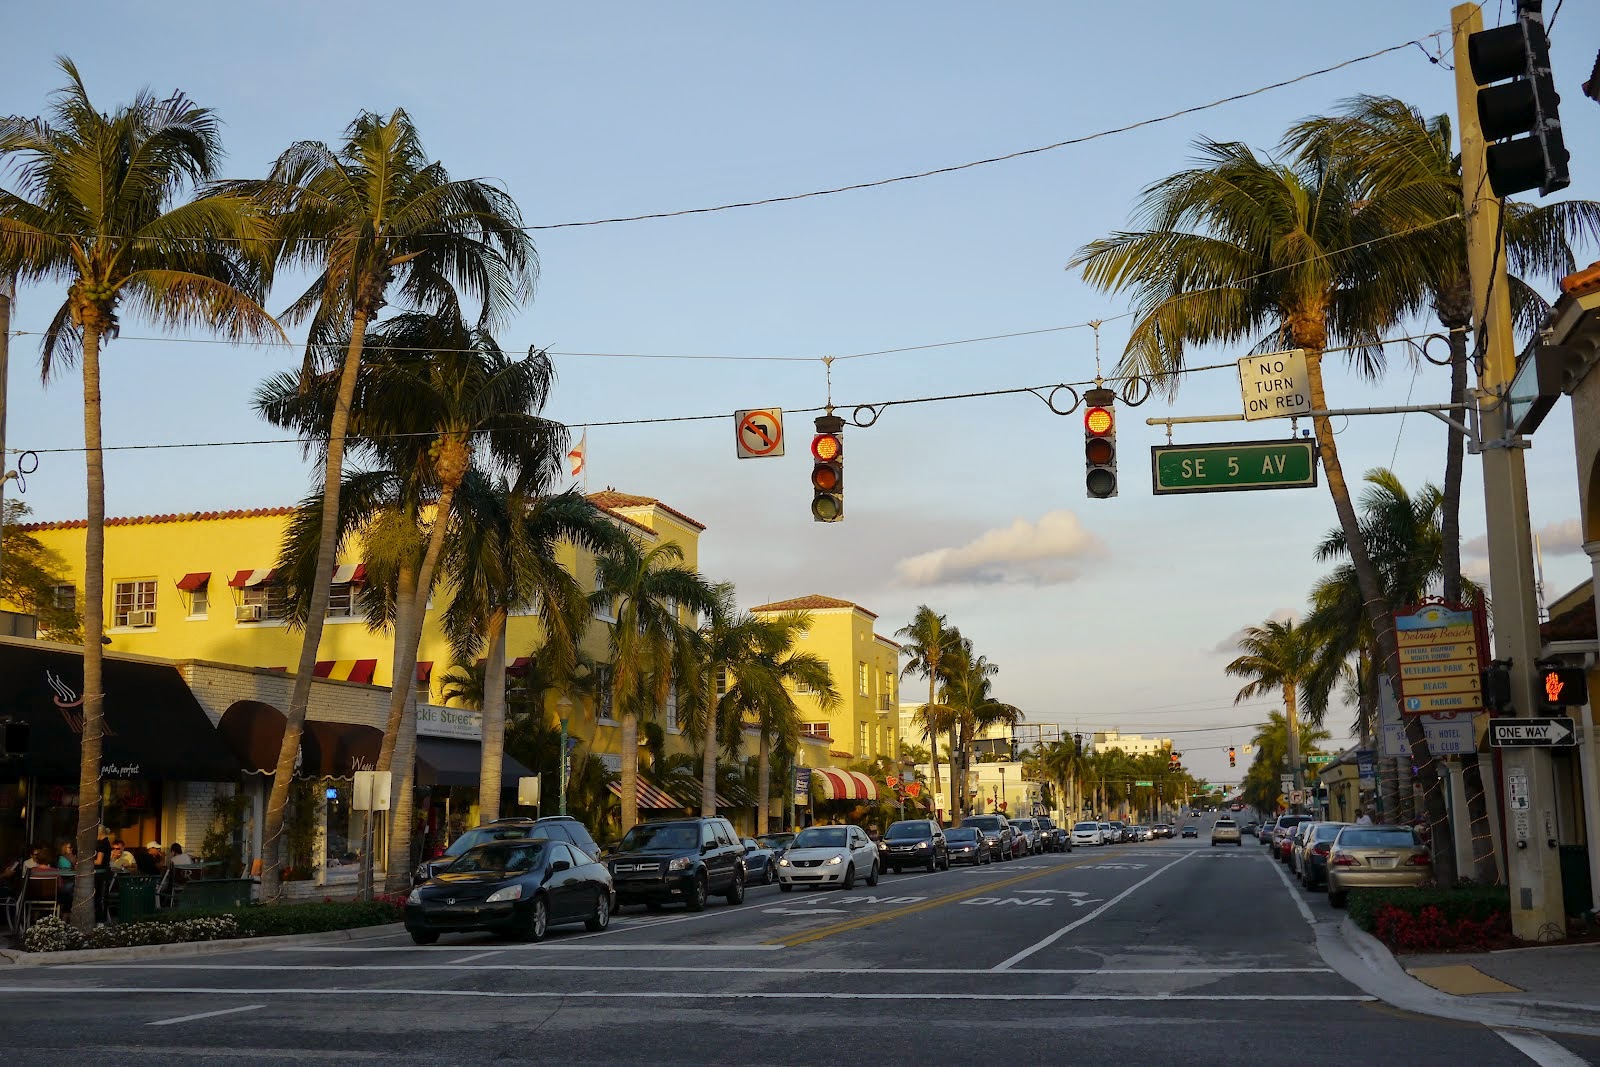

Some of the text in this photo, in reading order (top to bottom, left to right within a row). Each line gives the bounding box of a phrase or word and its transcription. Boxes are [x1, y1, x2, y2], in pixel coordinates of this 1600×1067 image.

[1260, 361, 1284, 375] NO
[1255, 377, 1294, 393] TURN
[1249, 394, 1304, 412] ON RED
[1181, 455, 1286, 479] SE 5 AV
[1401, 625, 1472, 643] Delray Beach
[1404, 664, 1463, 674] VETERANS PARK
[1423, 681, 1448, 690] BEACH
[1431, 697, 1462, 706] PARKING
[1439, 730, 1460, 739] HOTEL
[1499, 727, 1549, 738] ONE WAY
[1441, 743, 1460, 751] CLUB
[120, 763, 140, 778] perfect
[960, 897, 1104, 906] ONLY
